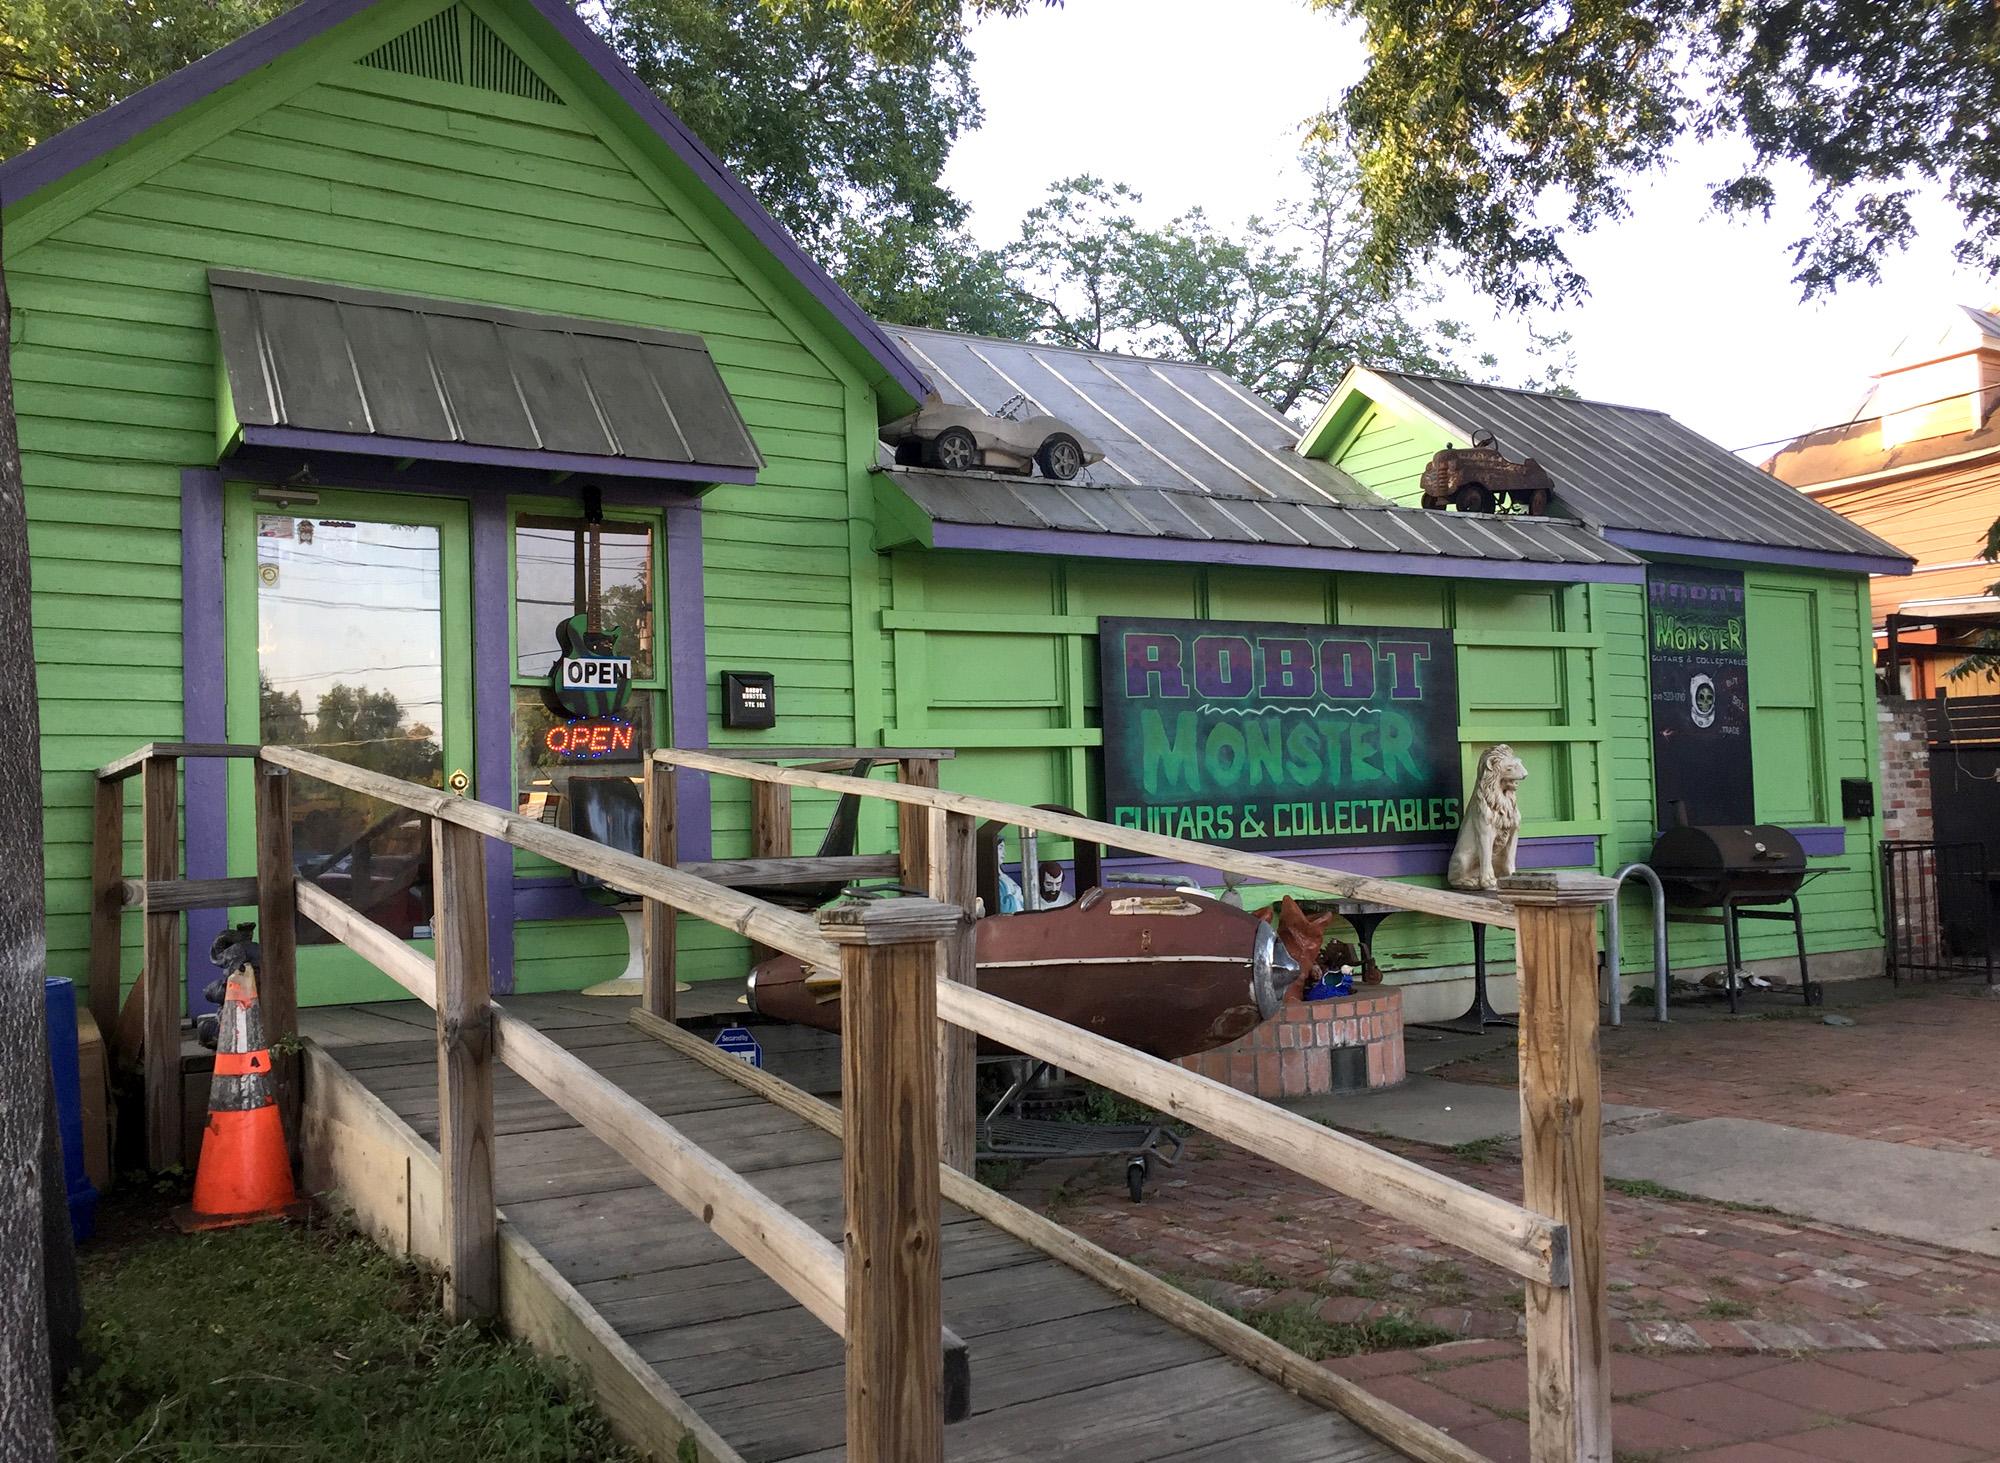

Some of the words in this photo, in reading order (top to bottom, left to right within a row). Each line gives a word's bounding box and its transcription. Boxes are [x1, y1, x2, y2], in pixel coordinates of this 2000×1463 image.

[1655, 614, 1744, 651] MONSTER
[567, 661, 628, 684] OPEN
[1123, 632, 1431, 700] ROBOT
[1652, 655, 1683, 663] GUITARS
[546, 727, 633, 751] OPEN
[1140, 709, 1424, 795] MONSTER
[1114, 804, 1234, 840] GUITARS
[1240, 804, 1268, 838] &
[1273, 798, 1461, 837] COLLECTABLES
